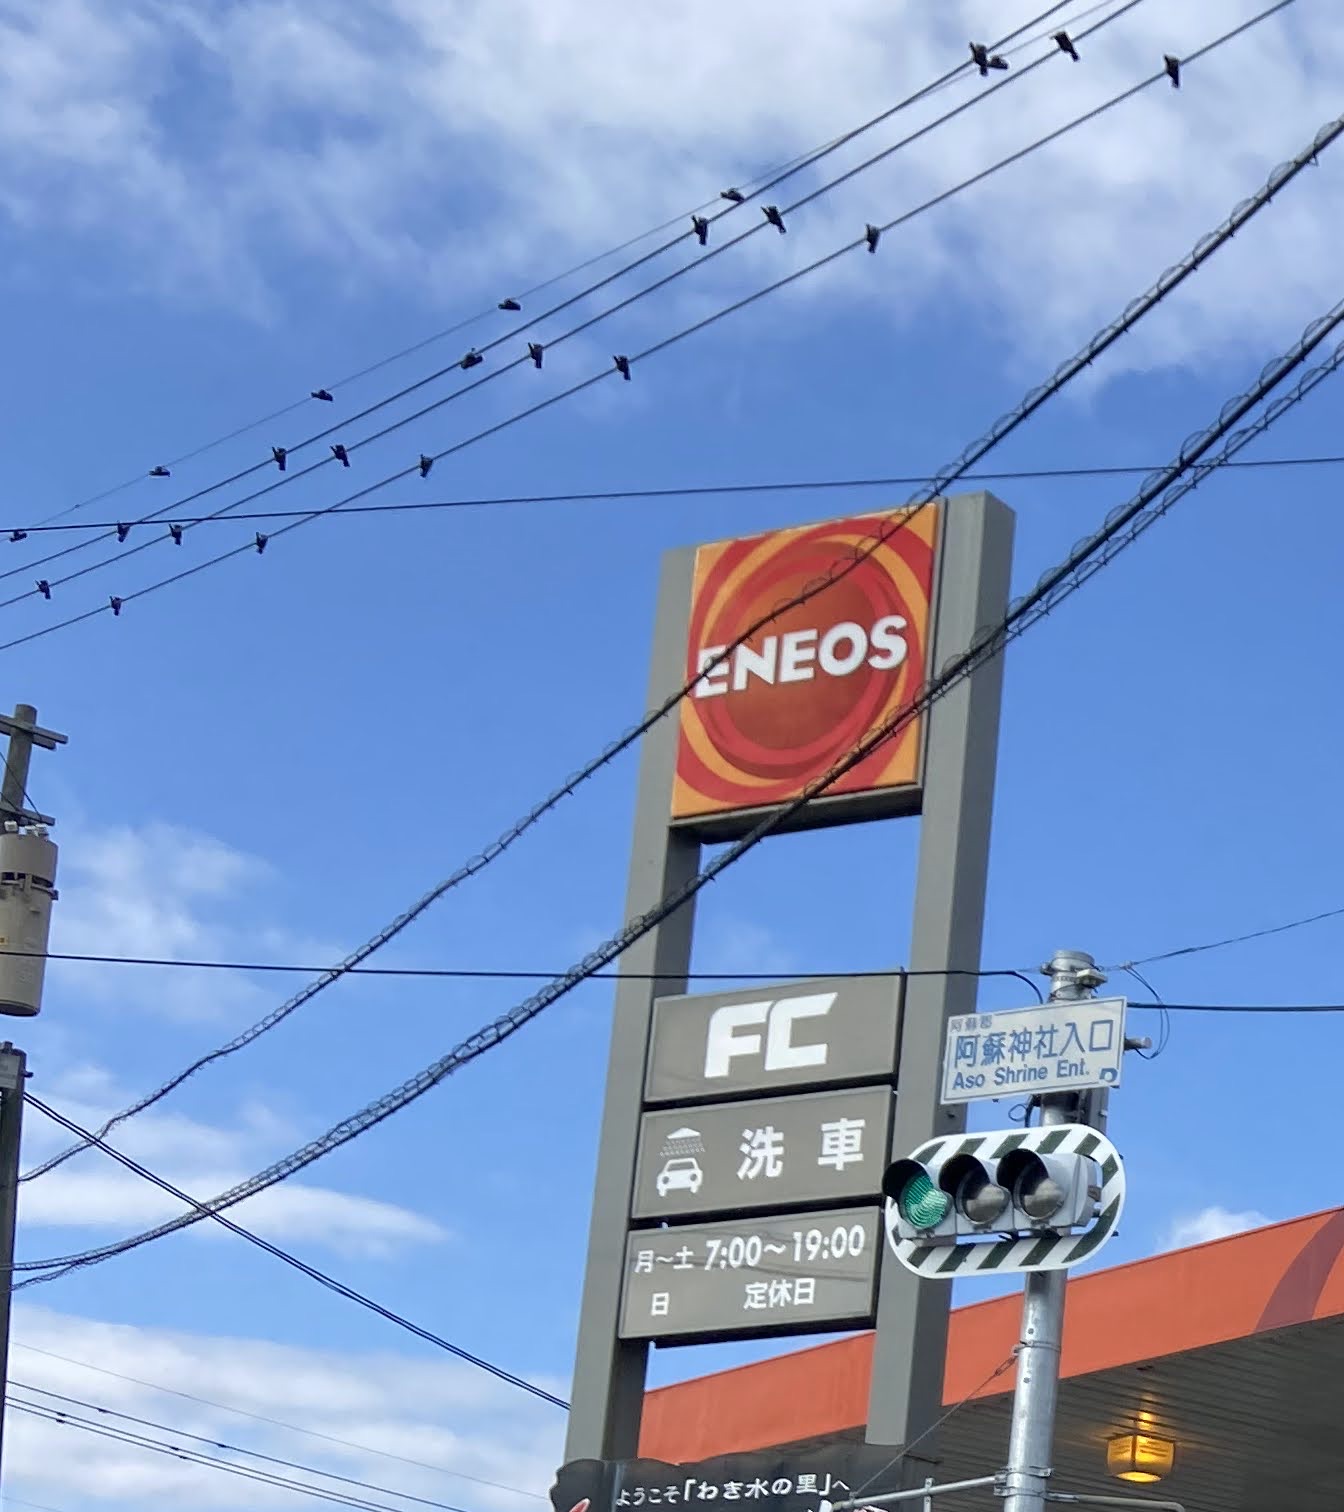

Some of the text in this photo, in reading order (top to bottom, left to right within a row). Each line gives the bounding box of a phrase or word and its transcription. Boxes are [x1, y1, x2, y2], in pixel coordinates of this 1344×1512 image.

[695, 615, 908, 699] ENEOS
[704, 992, 838, 1078] FC
[955, 1019, 1114, 1068] 阿蘇神社入口
[953, 1058, 1089, 1090] Aso Shrine Ent.
[737, 1118, 866, 1180] 洗車
[650, 1278, 816, 1317] 日 定休日
